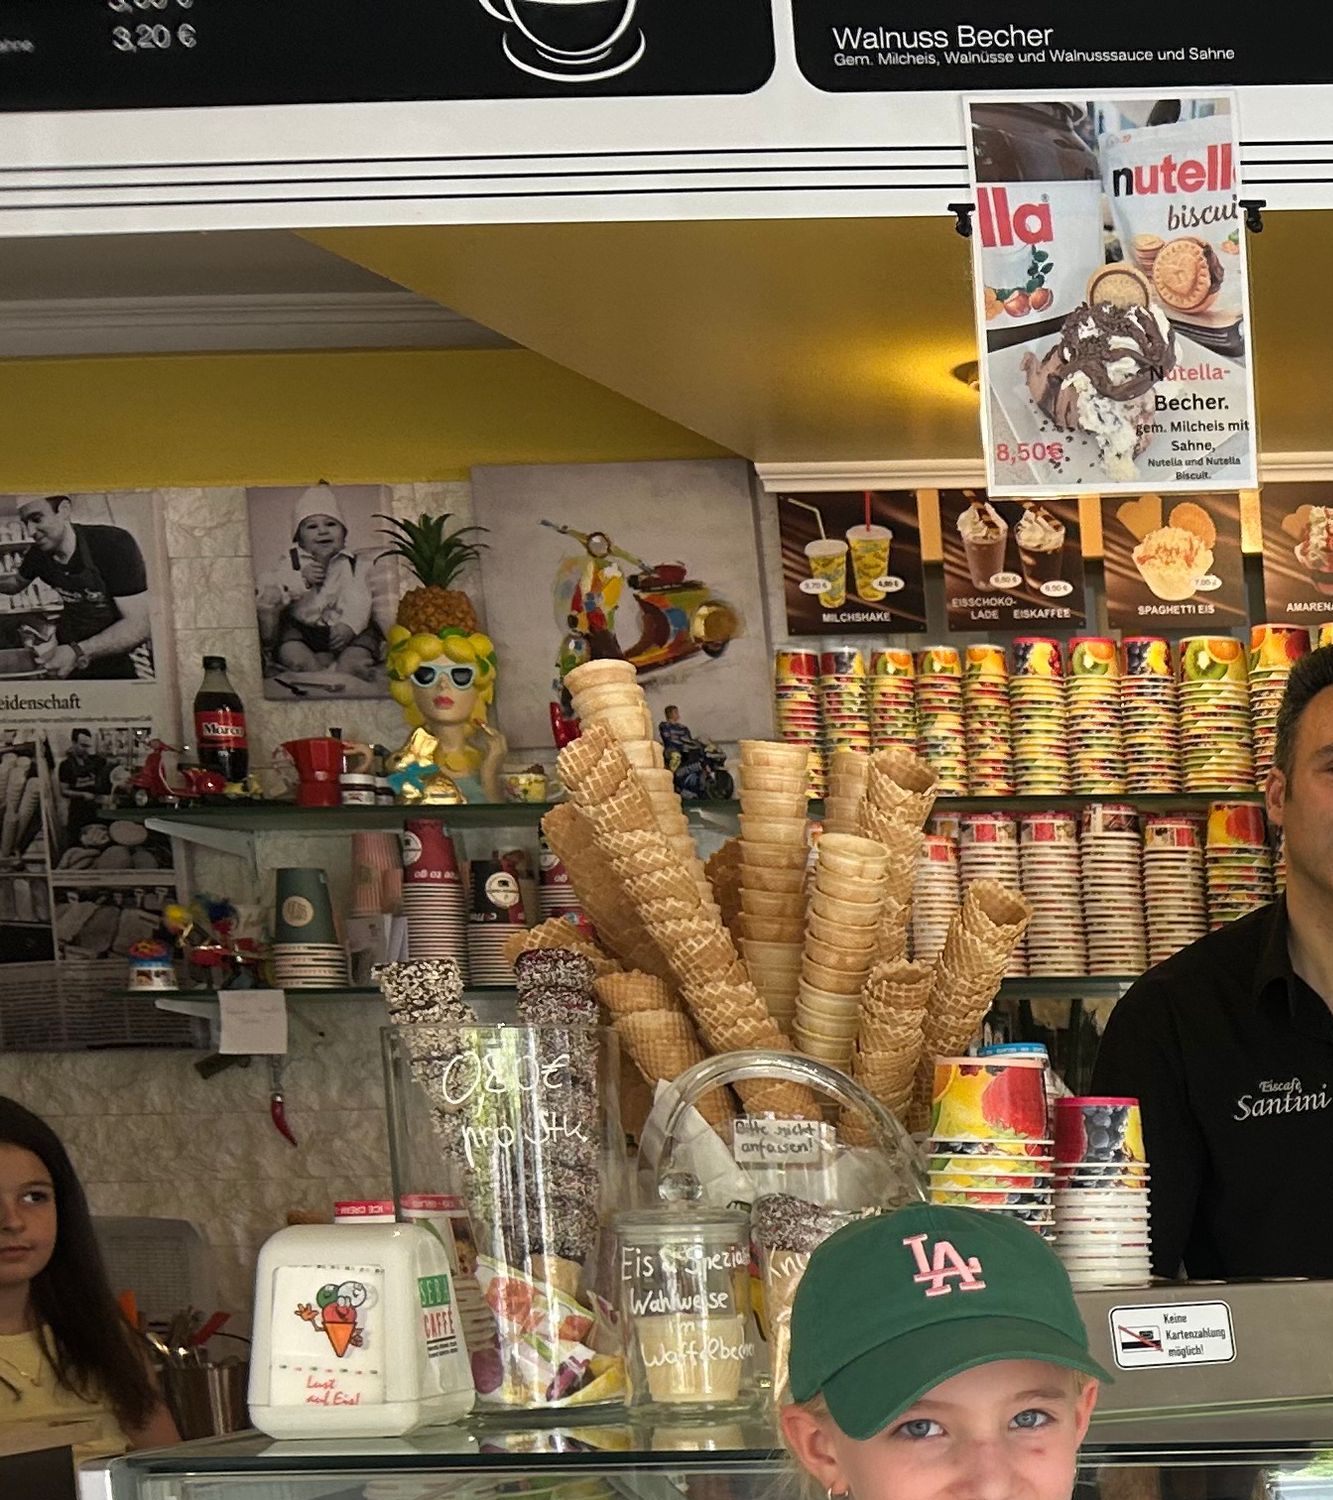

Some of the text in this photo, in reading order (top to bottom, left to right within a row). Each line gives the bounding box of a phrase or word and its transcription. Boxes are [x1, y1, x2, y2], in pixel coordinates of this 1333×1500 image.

[112, 23, 197, 52] 3,20 €
[833, 24, 1054, 49] Walnuss Becher
[833, 47, 1235, 67] Gem. Milcheis, Walnüsse und Walnusssauce und Sahne
[1112, 142, 1237, 198] nutell
[1149, 363, 1231, 382] Nutella-
[1154, 393, 1229, 412] Becher.
[1135, 419, 1250, 437] gem. Milcheis mit
[996, 442, 1065, 465] 8,50€
[1171, 439, 1216, 453] Sahne,
[1147, 456, 1241, 467] Nutella und Nutella
[1175, 471, 1212, 481] Biscuit.
[951, 597, 1017, 608] EISSCHOKO-
[1137, 604, 1215, 616] SPAGHETTI EIS
[822, 611, 891, 623] MILCHSHAKE
[970, 609, 1000, 620] LADE
[1013, 608, 1071, 620] EISKAFFEE
[1233, 1084, 1332, 1121] Santini
[621, 1246, 655, 1281] Eis
[902, 1233, 987, 1298] LA
[629, 1286, 729, 1316] Wahlweise
[1163, 1313, 1188, 1324] Keine
[1165, 1327, 1226, 1341] Kartenzahlung
[1168, 1343, 1204, 1359] möglich!
